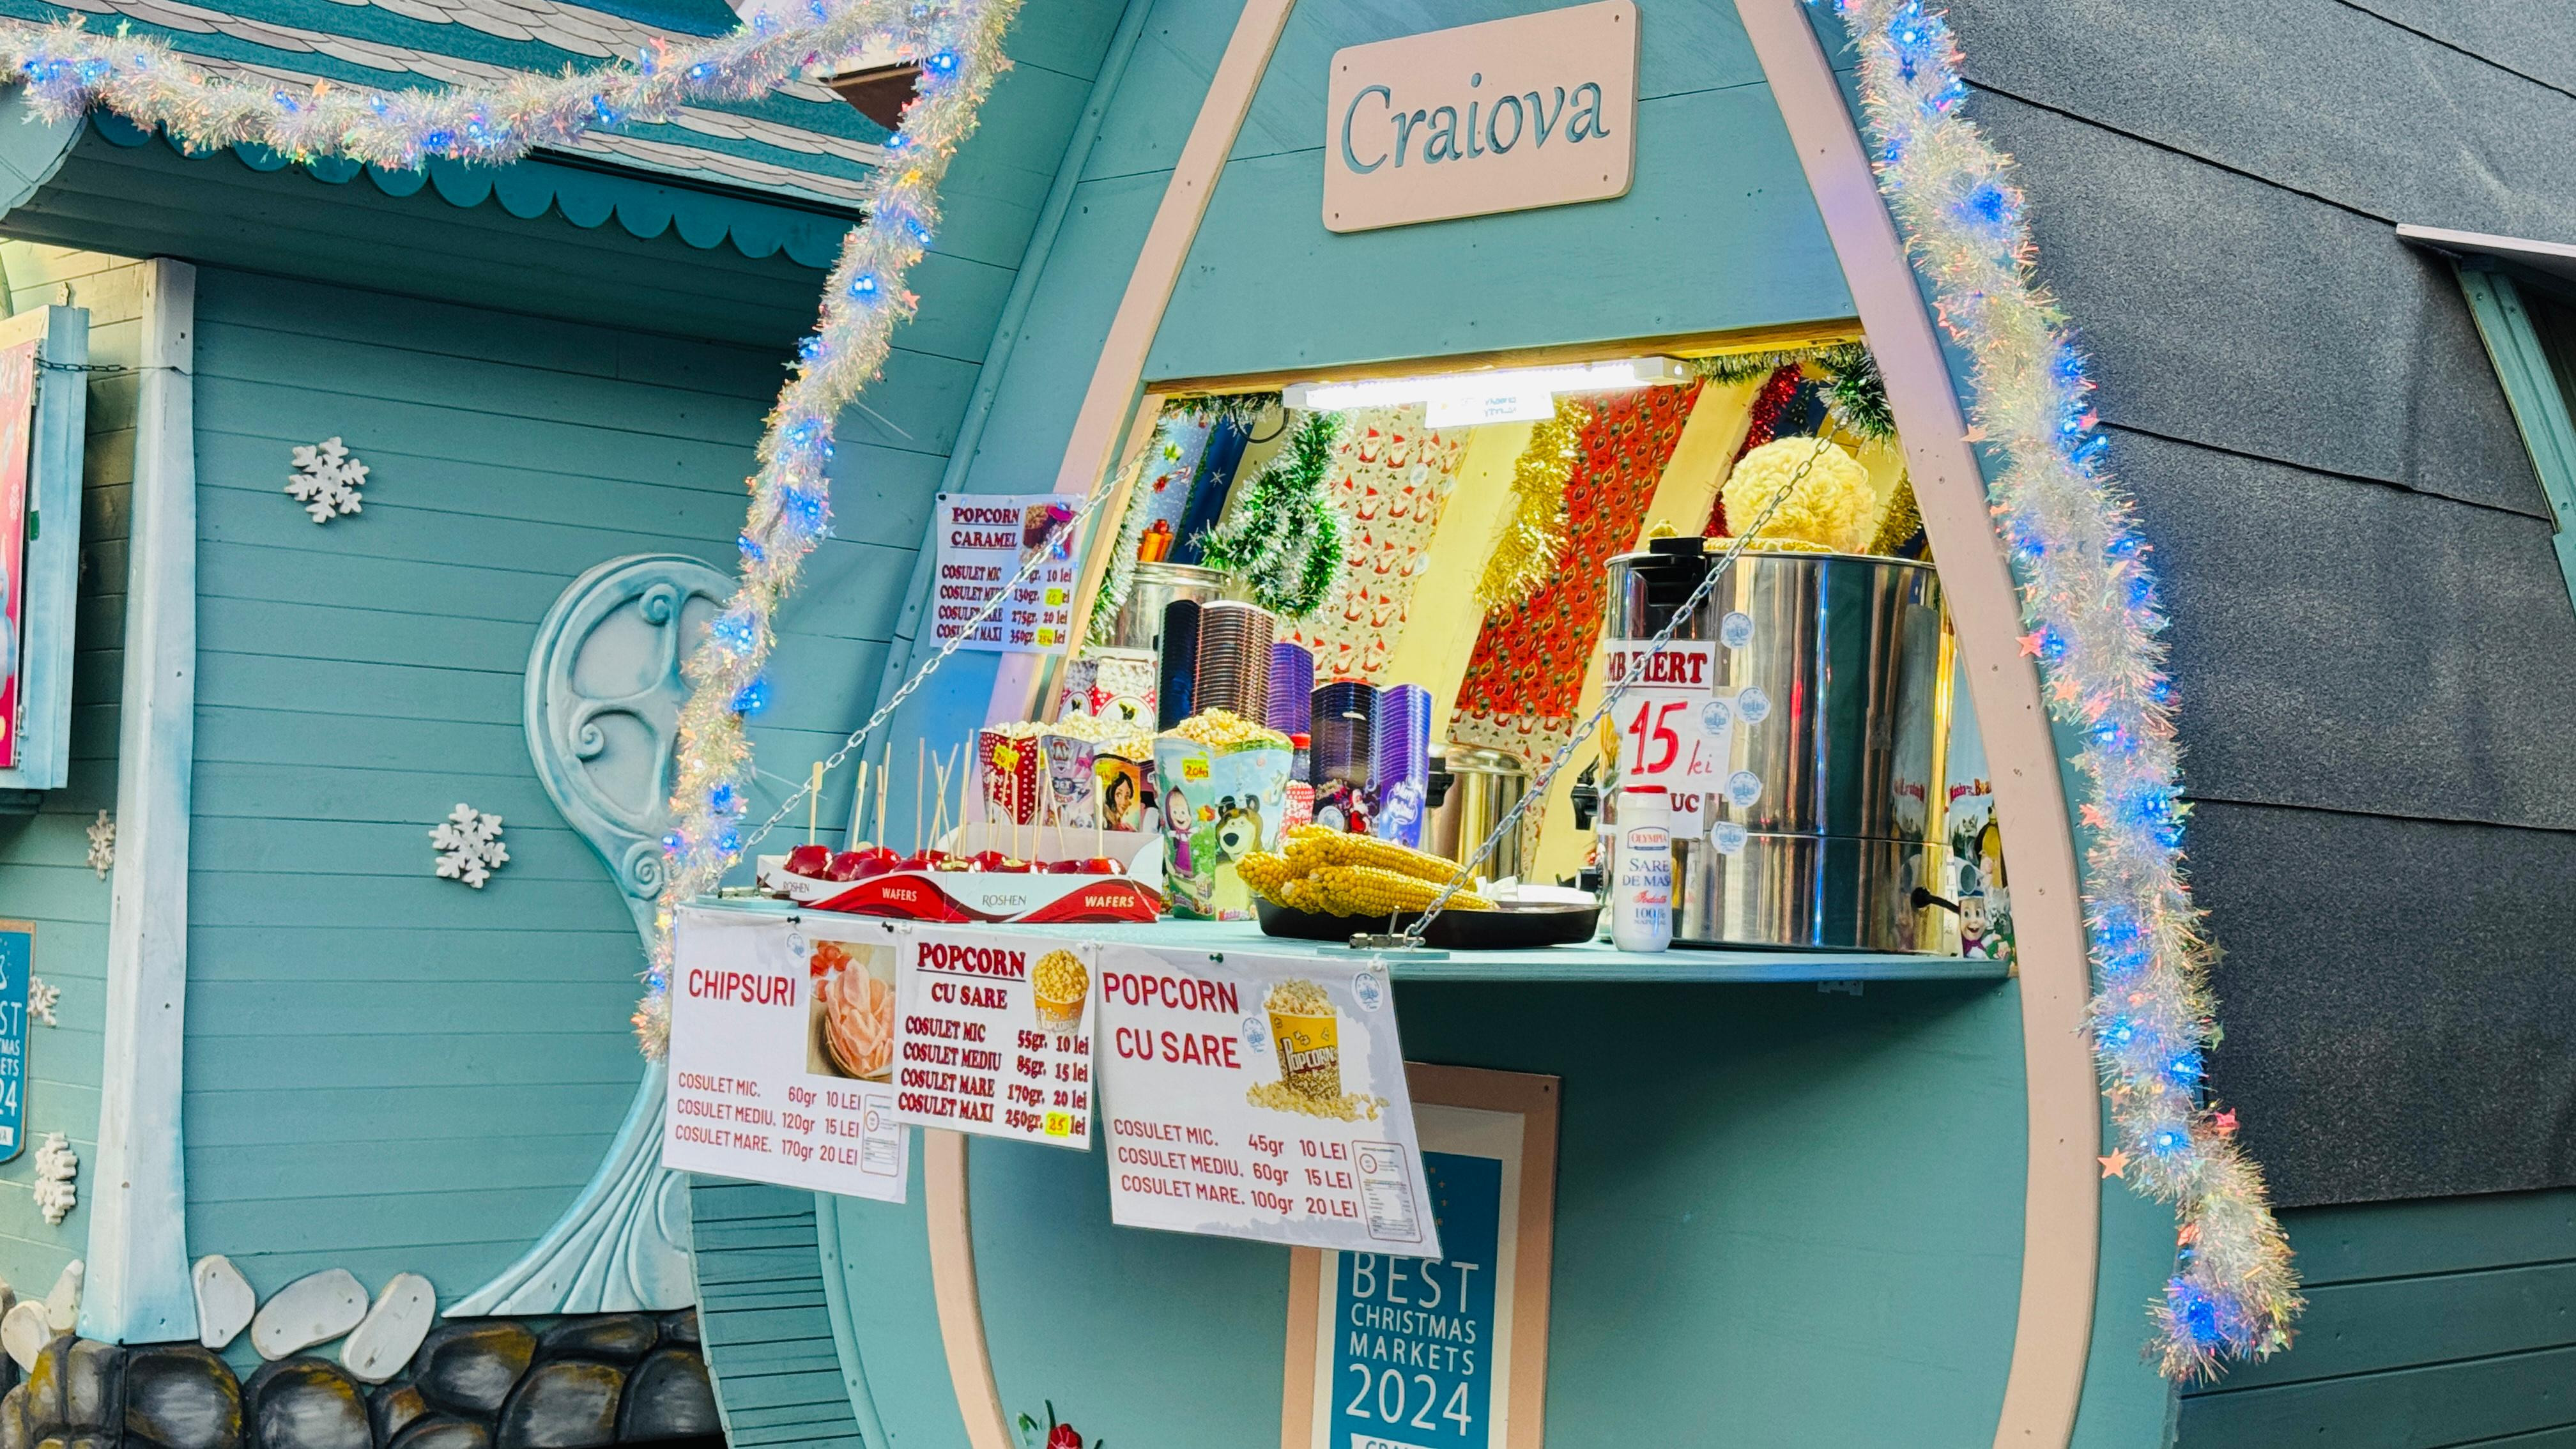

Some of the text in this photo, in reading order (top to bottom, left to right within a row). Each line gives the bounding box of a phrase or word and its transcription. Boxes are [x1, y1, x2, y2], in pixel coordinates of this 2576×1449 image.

[1341, 72, 1611, 174] Craiova
[952, 507, 1020, 523] POPCORN
[951, 531, 1018, 548] CARAMEL
[940, 585, 983, 601] COSULET
[942, 565, 985, 581] COSULET
[986, 566, 1002, 581] MIC
[1046, 569, 1058, 583] 10
[1060, 567, 1073, 583] lei
[938, 605, 981, 622] COSULET
[981, 607, 1003, 622] ARE
[1042, 611, 1054, 624] 20
[1057, 610, 1068, 625] lei
[981, 626, 1002, 642] MAXI
[1054, 629, 1066, 645] lei
[1628, 701, 1688, 776] 15
[1669, 792, 1699, 813] UC
[1622, 875, 1641, 887] DE
[1629, 857, 1670, 873] SARE
[782, 881, 811, 893] ROSHEN
[882, 887, 917, 903] WAFERS
[981, 894, 1027, 907] ROSHEN
[1085, 894, 1135, 908] WAFERS
[917, 942, 1026, 978] POPCORN
[688, 968, 797, 1008] CHIPSURI
[931, 982, 1008, 1010] CU SARE
[1103, 971, 1239, 1015] POPCORN
[905, 1015, 1089, 1055] COSULET MIC 55gr. 10 lei
[1116, 1027, 1242, 1070] CU SARE
[903, 1041, 1088, 1083] COSULET MEDIU 85gr. 15 lei
[678, 1072, 861, 1110] COSULET MIC. 60gr 10 LEI
[901, 1068, 1087, 1110] COSULET MARE 170gr. 20 lei
[677, 1098, 859, 1138] COSULET MEDIU. 120gr 15 LEI
[898, 1092, 1085, 1137] COSULET MAXI 250gr. 25 lei
[675, 1125, 858, 1166] COSULET MARE. 170gr 20 LEI
[1114, 1118, 1347, 1162] COSULET MIC. 45gr 10 LEI
[1118, 1146, 1353, 1190] COSULET MEDIU. 60gr 15 LEI
[1121, 1174, 1360, 1219] COSULET MARE. 100gr 20 LEI
[1353, 1252, 1480, 1314] BEST
[1351, 1303, 1477, 1345] CHRISTMAS
[1349, 1331, 1475, 1376] MARKETS
[1346, 1363, 1472, 1437] 2024
